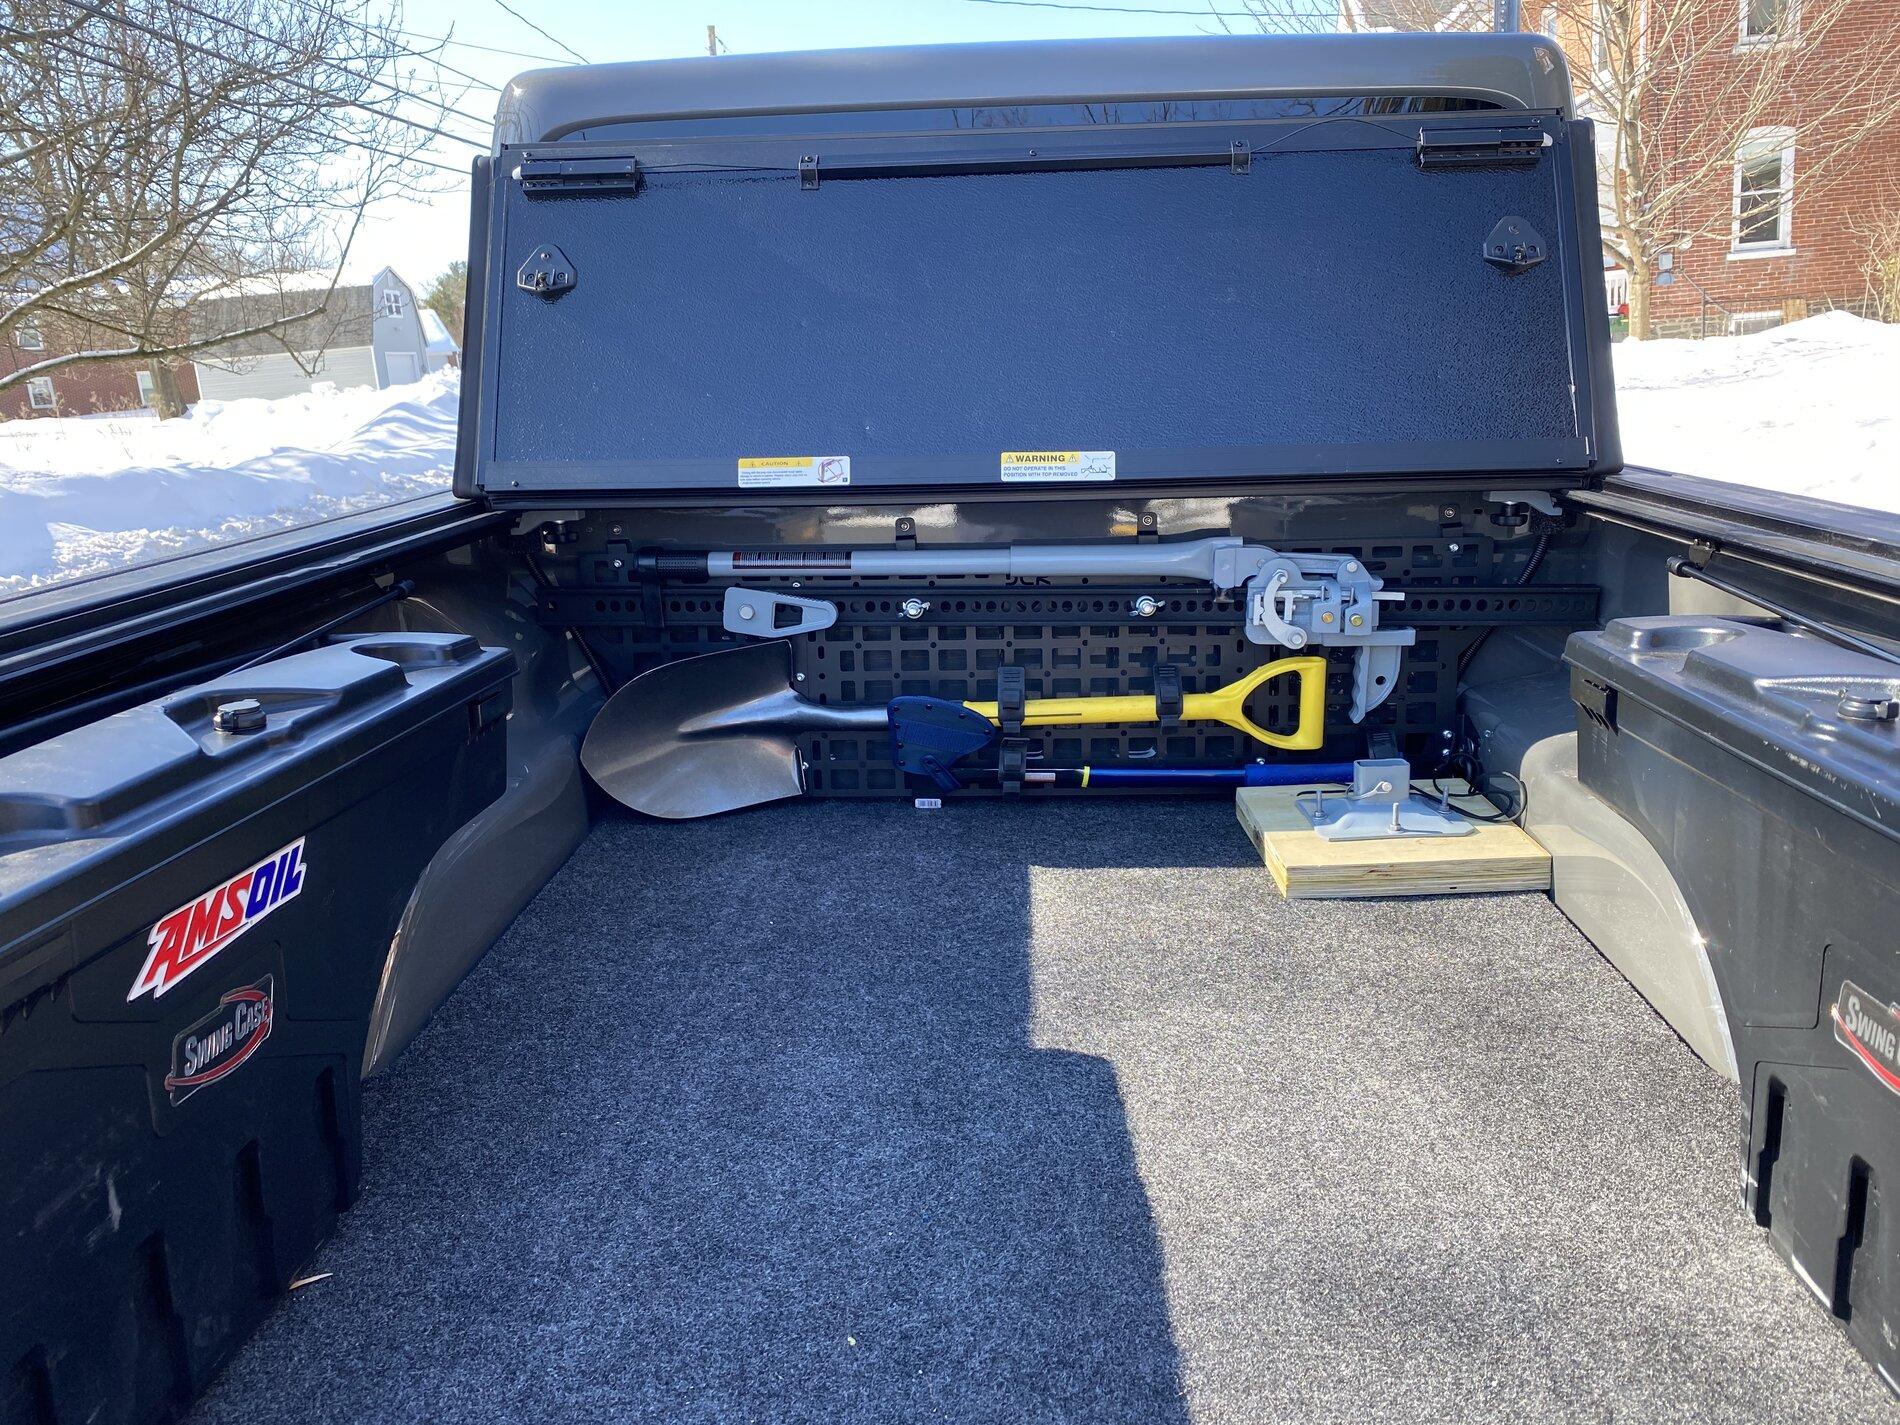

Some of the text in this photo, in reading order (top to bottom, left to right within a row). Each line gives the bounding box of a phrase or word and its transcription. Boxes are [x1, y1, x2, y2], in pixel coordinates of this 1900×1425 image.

[1015, 454, 1066, 463] WARNING
[141, 845, 304, 988] AMSOIL
[1845, 994, 1896, 1061] SWING
